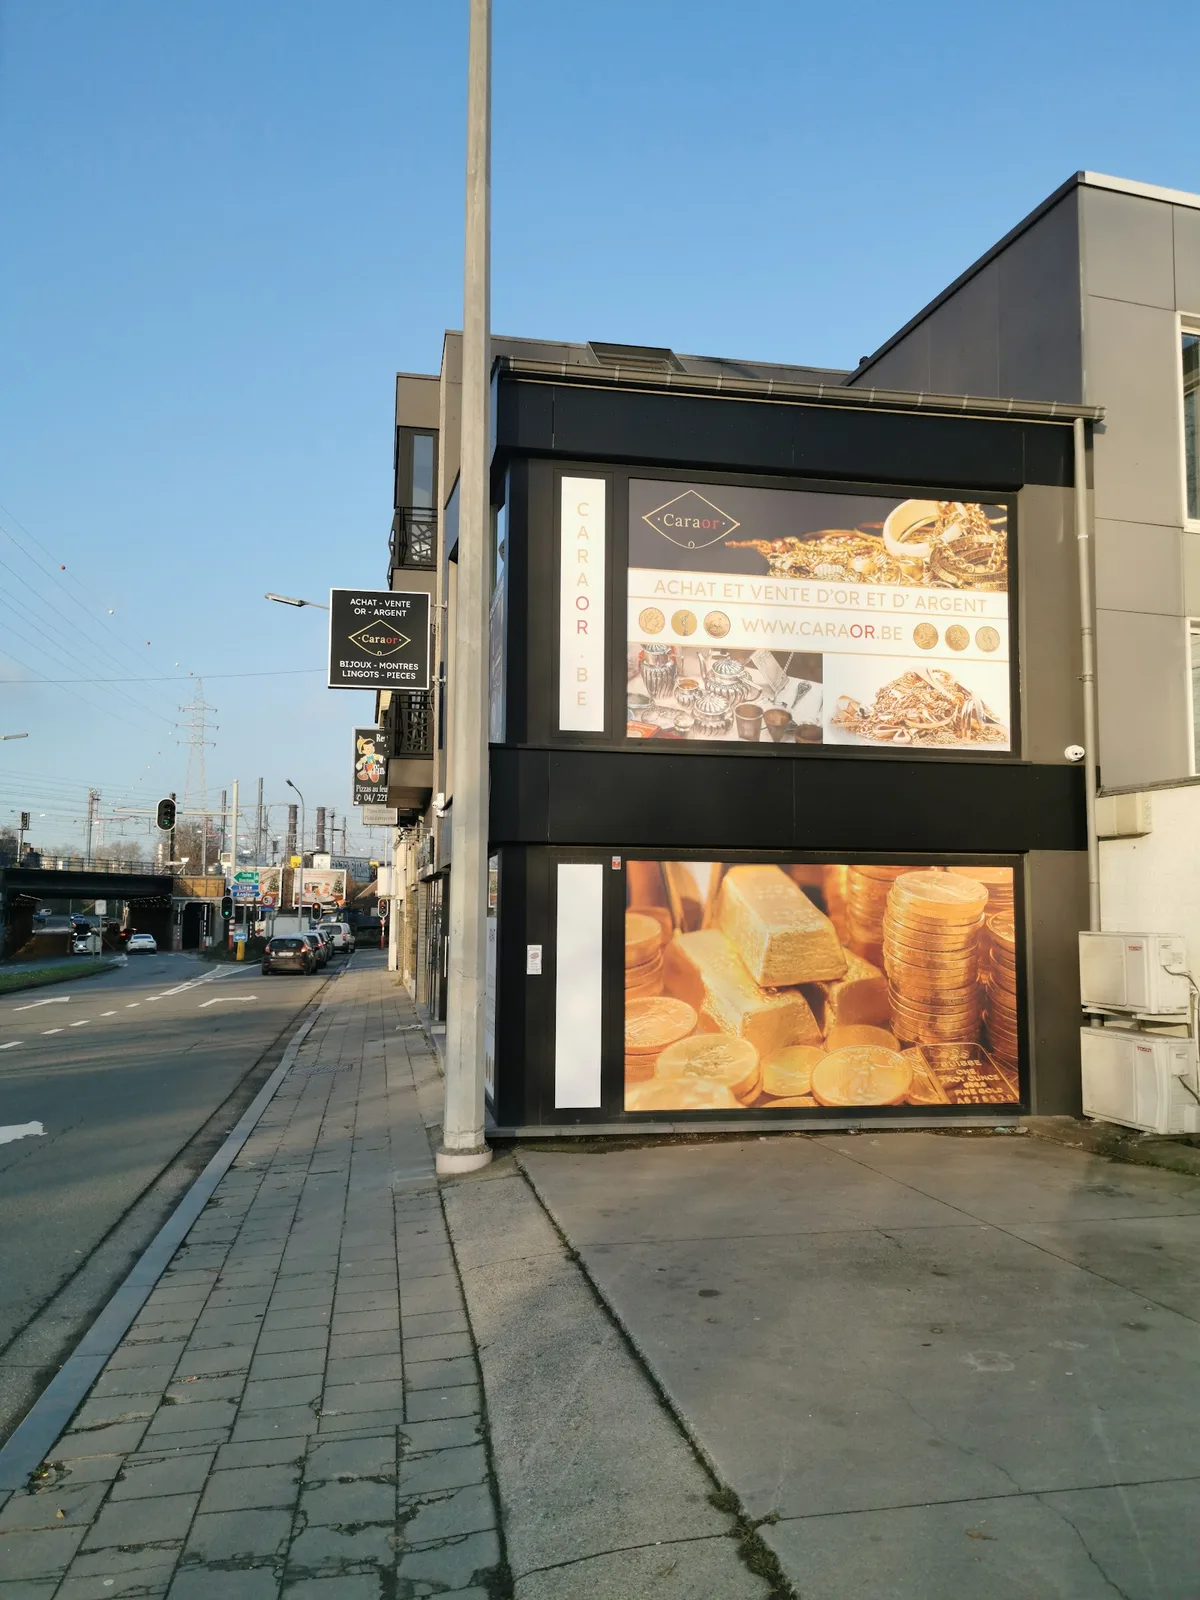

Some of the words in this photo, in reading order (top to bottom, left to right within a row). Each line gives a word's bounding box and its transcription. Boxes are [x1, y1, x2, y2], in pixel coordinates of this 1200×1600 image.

[663, 513, 719, 530] Caraor
[654, 579, 716, 597] ACHAT
[723, 583, 744, 598] ET
[751, 584, 810, 602] VENTE
[867, 592, 887, 607] ET
[915, 595, 987, 613] ARGENT
[350, 598, 377, 606] ACHAT
[384, 600, 411, 608] VENTE
[374, 609, 407, 617] ARGENT
[742, 617, 902, 641] WWW.CARAOR.BE
[361, 634, 398, 645] Caraor
[340, 660, 372, 669] BIJOUX
[379, 662, 419, 671] MONTRES
[342, 670, 379, 679] LINGOTS
[386, 672, 416, 680] PIECES
[356, 784, 371, 792] Pizzas
